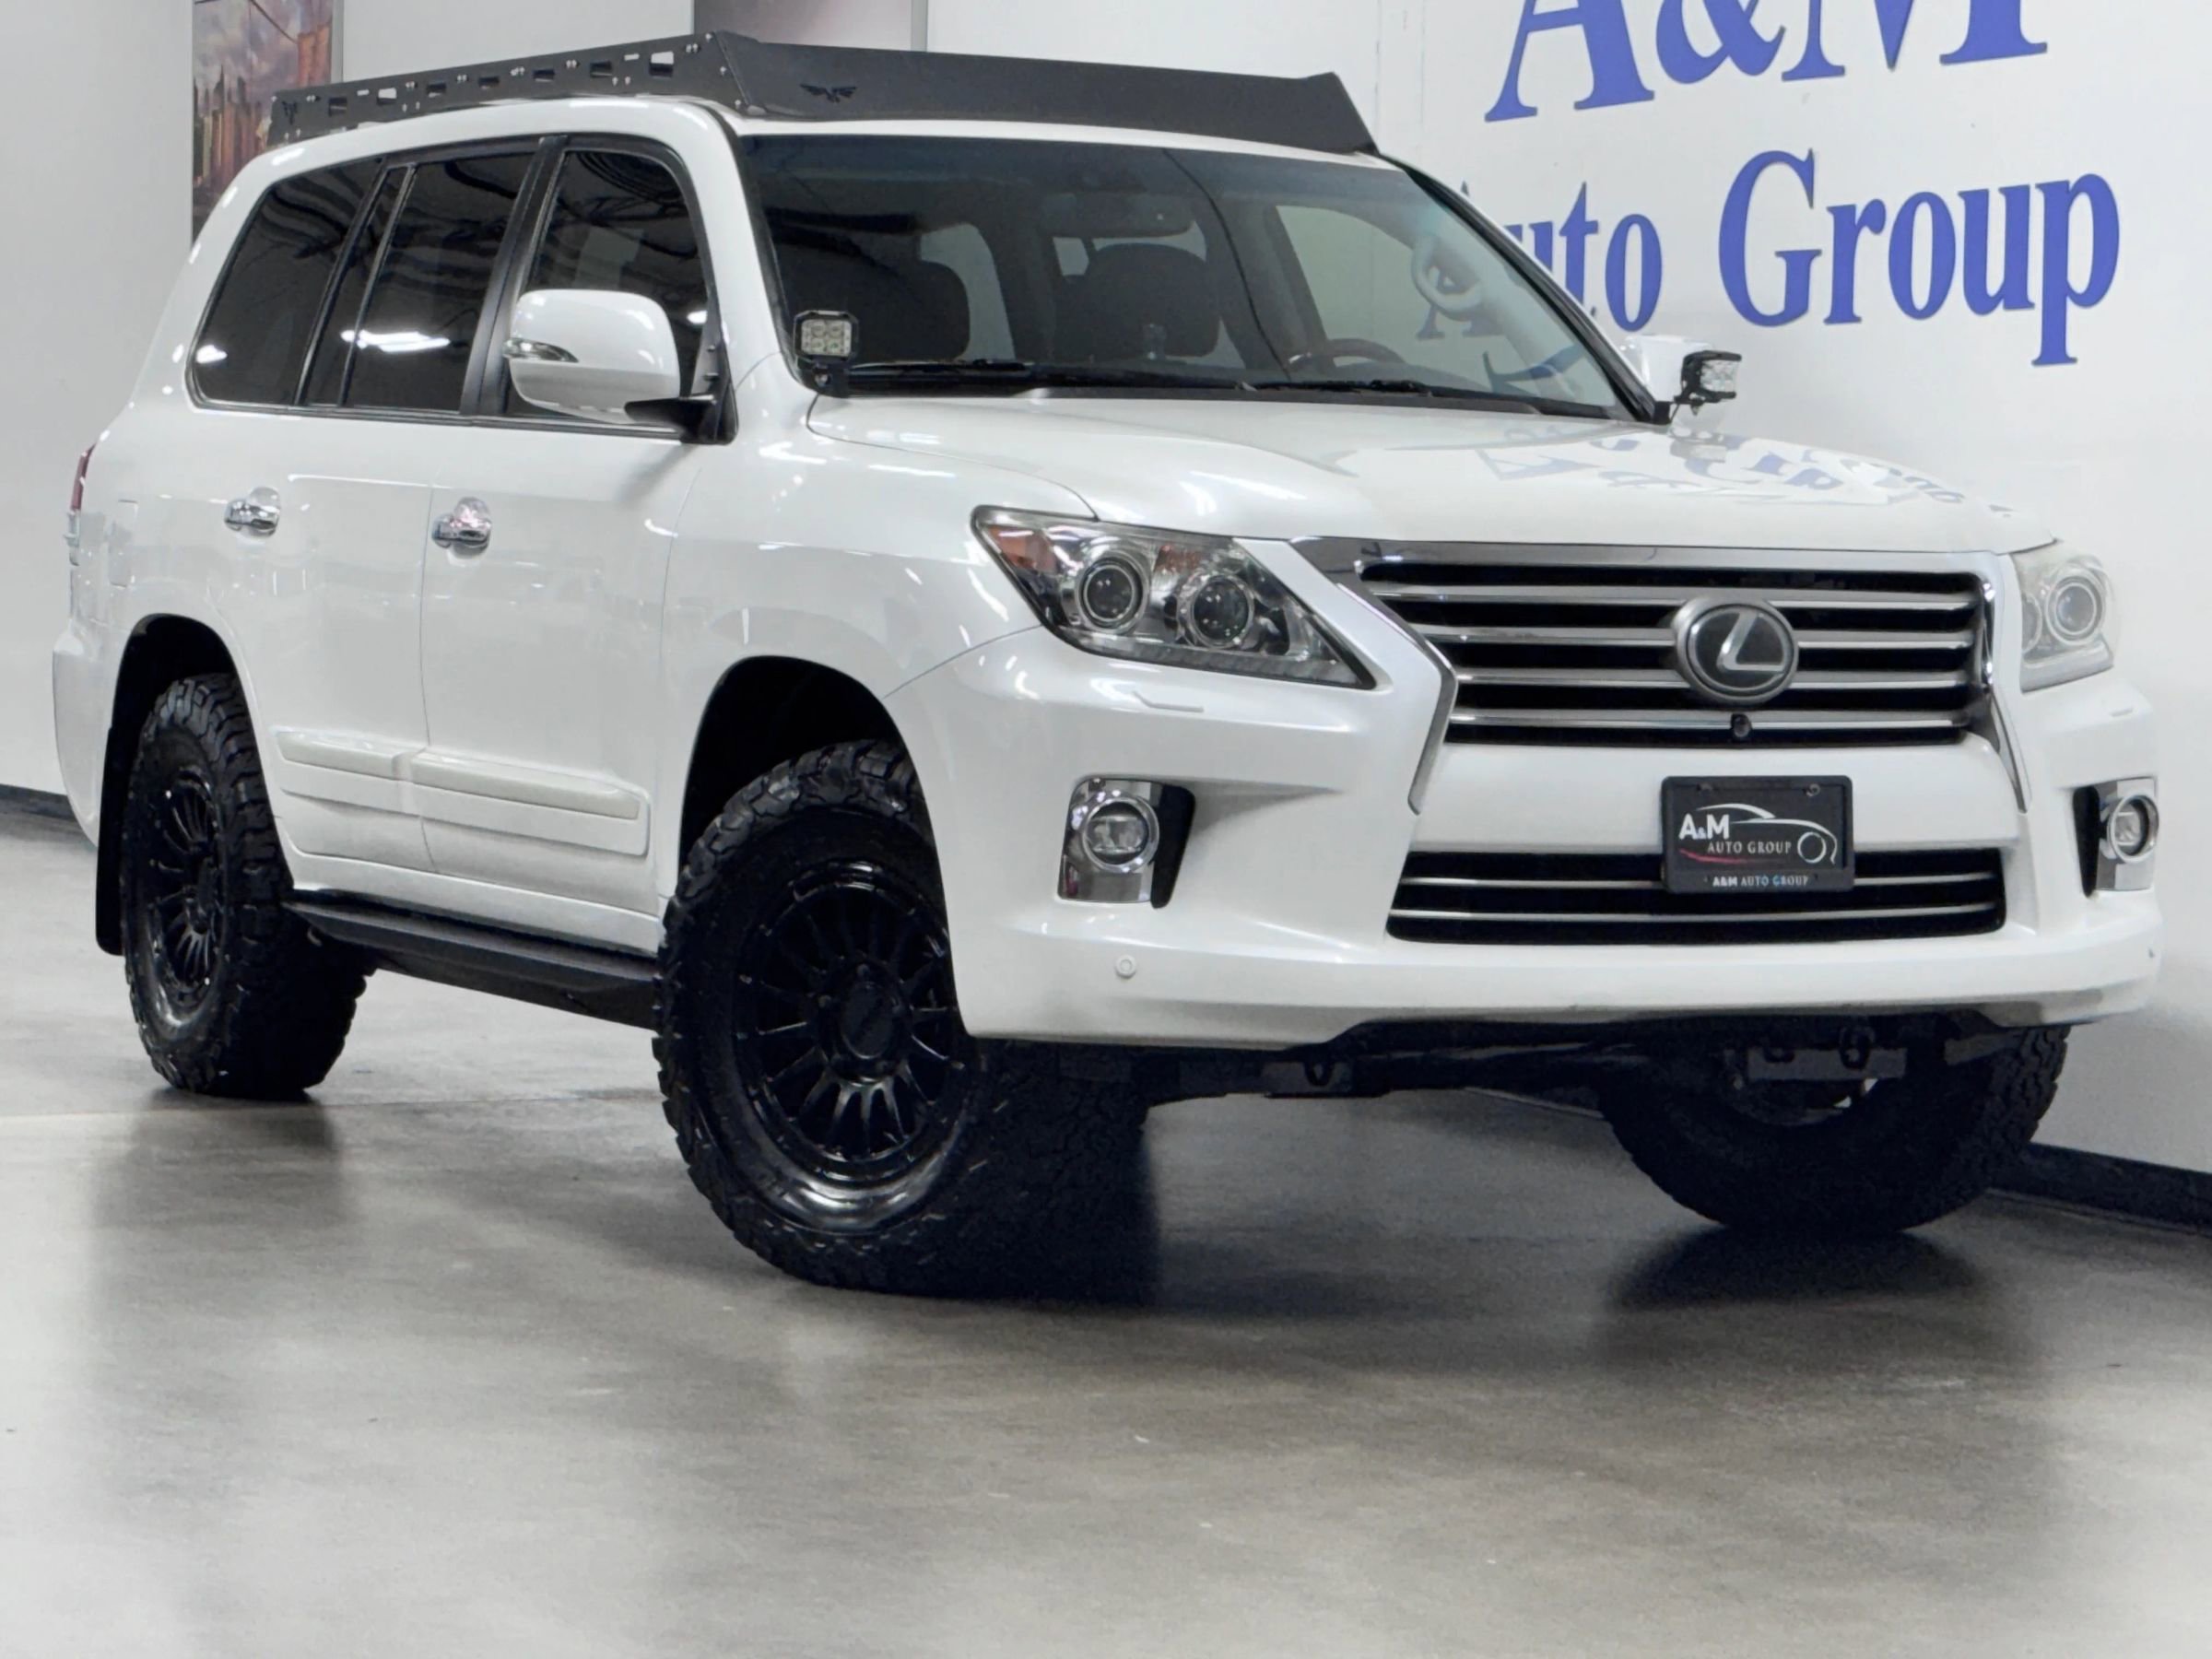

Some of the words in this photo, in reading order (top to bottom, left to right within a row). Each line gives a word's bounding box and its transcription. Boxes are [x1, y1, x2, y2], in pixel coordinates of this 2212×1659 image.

[1719, 149, 2120, 366] Group
[1678, 813, 1730, 841] A&M
[1707, 841, 1743, 854] AUTO
[1747, 841, 1792, 854] GROUP
[1740, 876, 1770, 887] AUTO
[1772, 875, 1808, 887] GROUP
